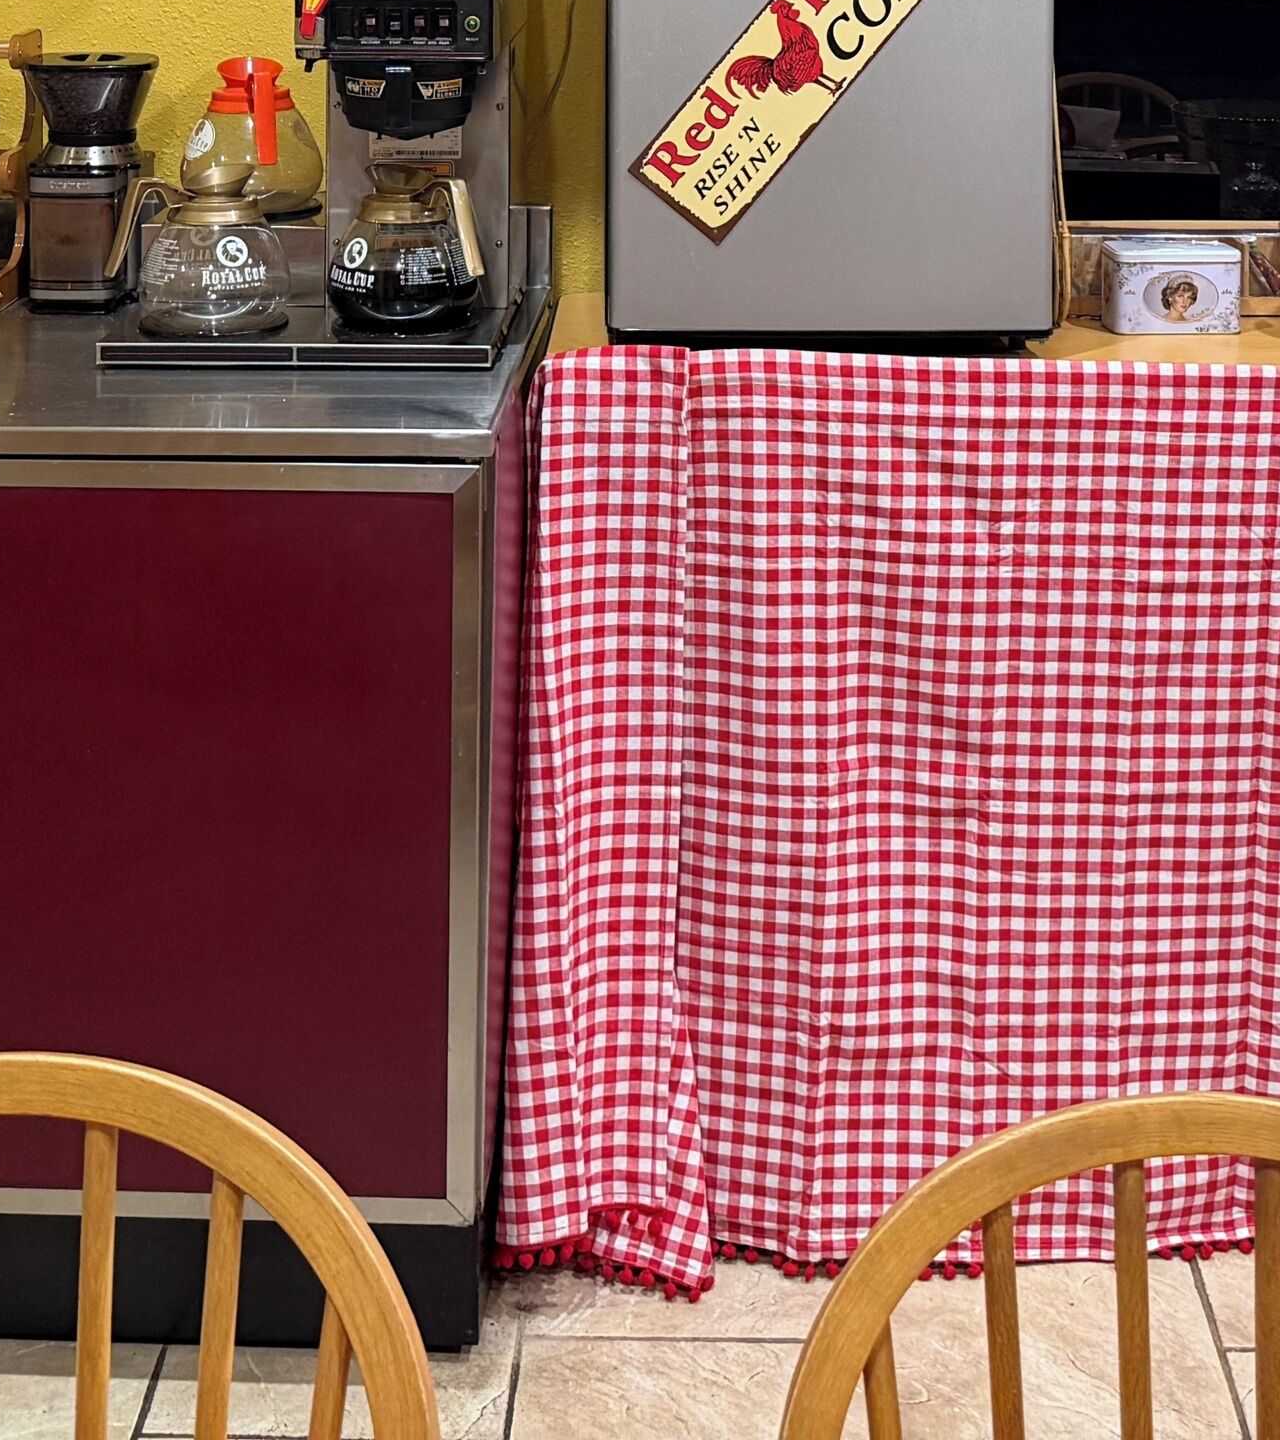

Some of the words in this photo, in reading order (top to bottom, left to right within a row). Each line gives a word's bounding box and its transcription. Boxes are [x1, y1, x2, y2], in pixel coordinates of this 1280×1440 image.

[644, 86, 739, 187] Red
[694, 143, 740, 200] RISE
[714, 133, 781, 216] SHINE
[202, 268, 243, 286] ROYAL
[244, 265, 266, 281] CUP
[330, 265, 352, 283] ROYAL
[353, 271, 375, 288] CUP
